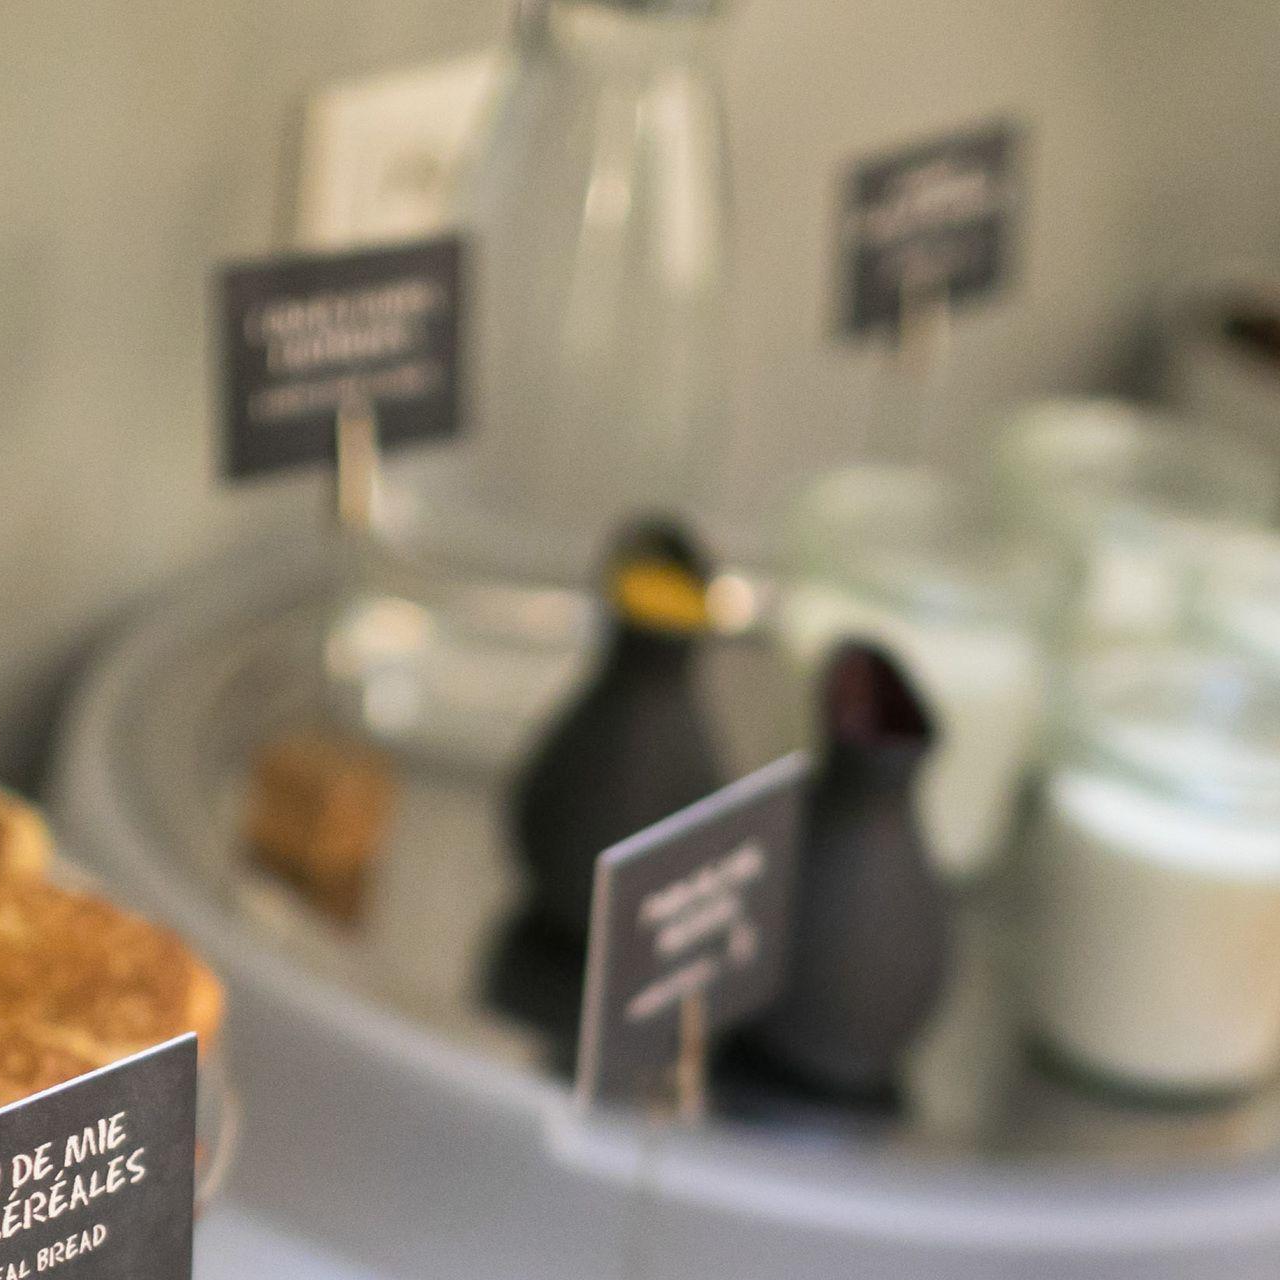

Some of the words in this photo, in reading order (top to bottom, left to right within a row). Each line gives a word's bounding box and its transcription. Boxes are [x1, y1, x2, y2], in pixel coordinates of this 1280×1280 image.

[12, 1141, 52, 1188] DE
[63, 1111, 128, 1168] MIE
[36, 1223, 108, 1272] BREAD
